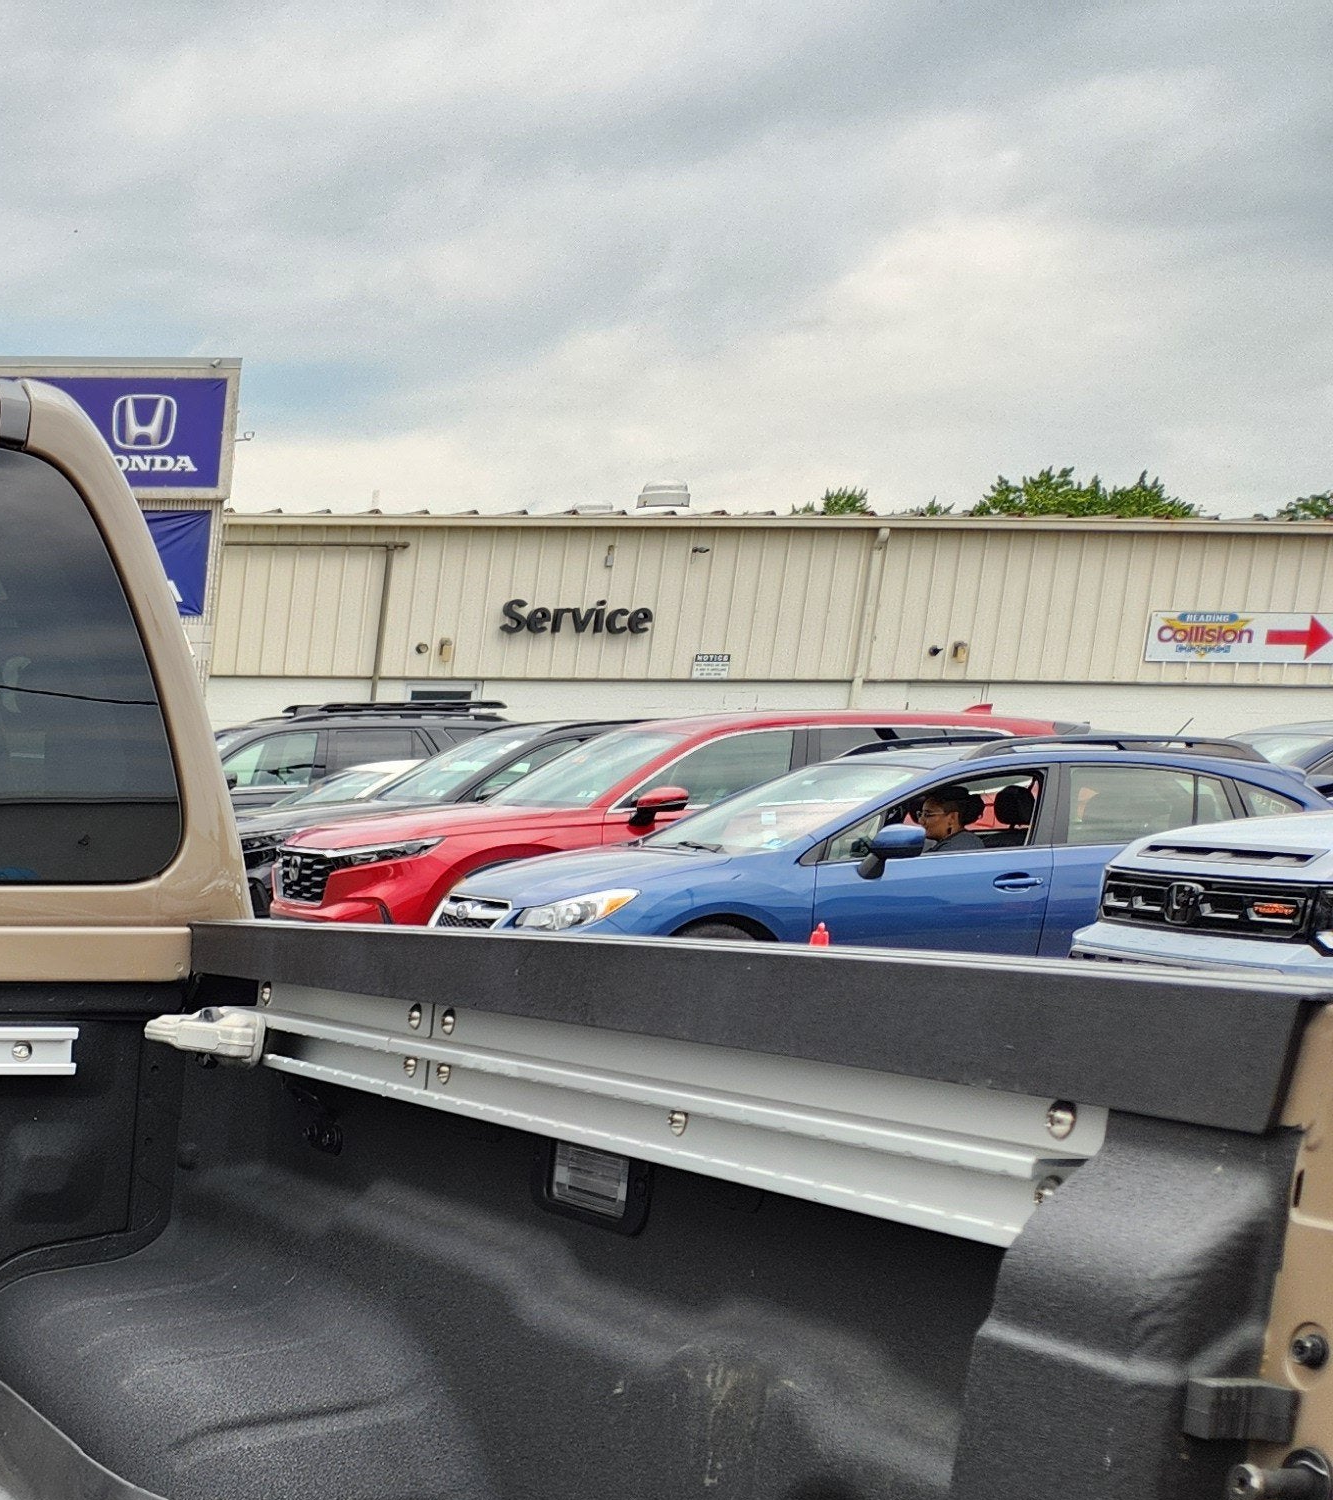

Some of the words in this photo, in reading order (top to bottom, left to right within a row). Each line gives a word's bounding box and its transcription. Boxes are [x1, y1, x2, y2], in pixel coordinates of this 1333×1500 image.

[113, 455, 197, 472] ONDA
[500, 599, 653, 634] Service
[1157, 625, 1254, 643] Collision
